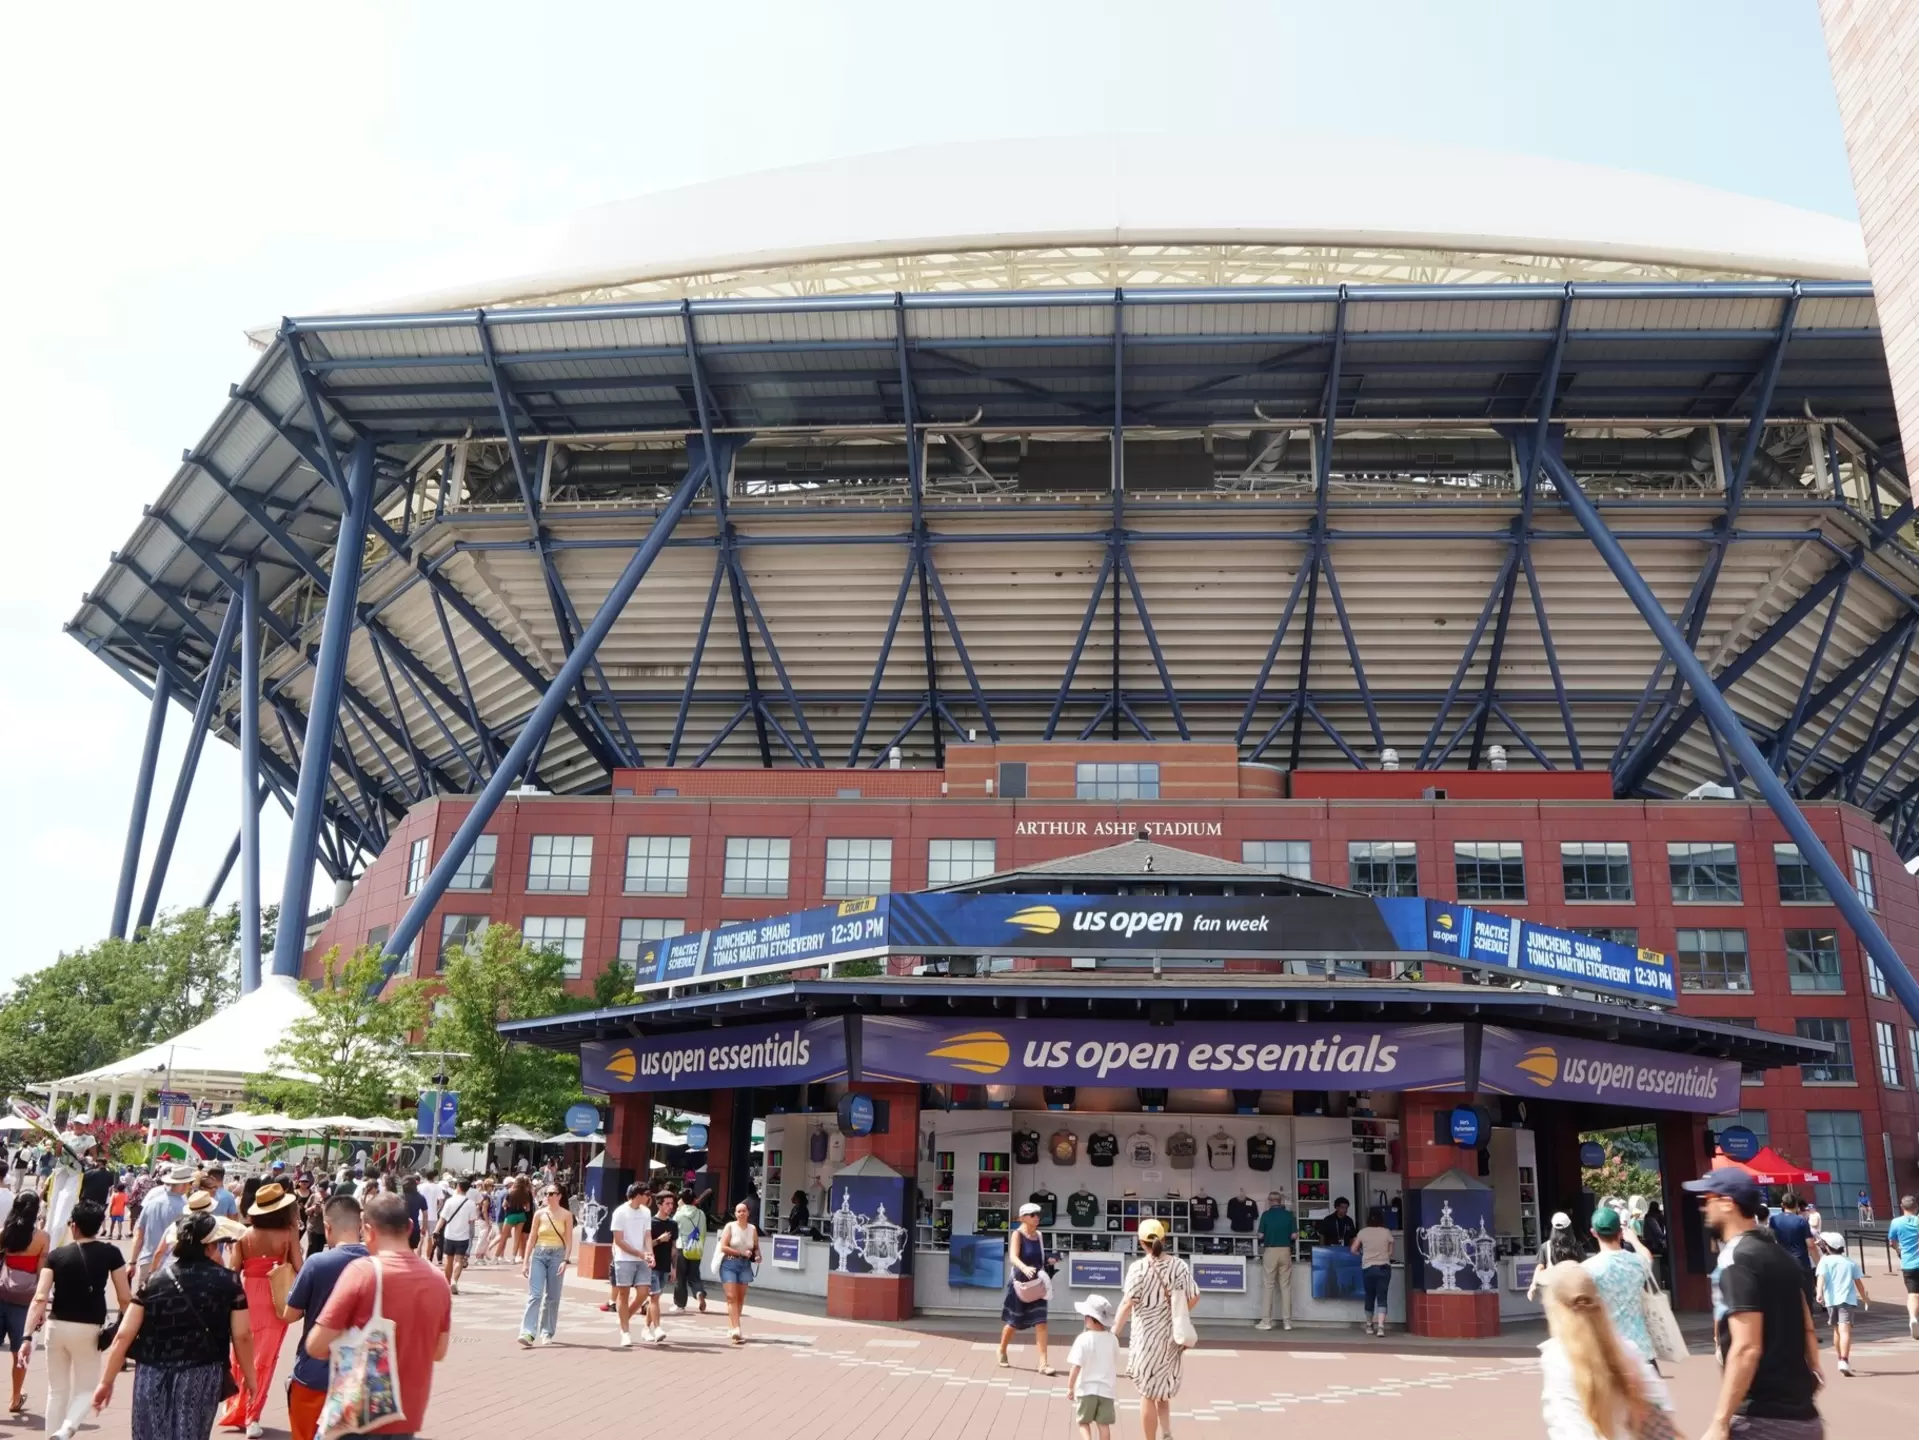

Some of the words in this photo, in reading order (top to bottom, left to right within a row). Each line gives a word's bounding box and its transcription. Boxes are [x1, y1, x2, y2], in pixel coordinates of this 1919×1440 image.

[1015, 821, 1088, 836] ARTHUR
[1093, 822, 1137, 836] ASHE
[1144, 822, 1222, 836] STADIUM
[844, 900, 865, 914] COURT
[713, 928, 757, 951] JUNCHENG
[760, 922, 791, 943] SHANG
[831, 920, 863, 945] 12:30
[865, 916, 884, 939] PM
[1073, 911, 1108, 931] us
[1109, 911, 1183, 938] open
[1193, 914, 1221, 931] fan
[1226, 915, 1270, 932] week
[1433, 930, 1441, 940] us
[1441, 932, 1458, 944] open
[1475, 921, 1510, 941] PRACTICE
[670, 942, 699, 958] PRACTICE
[712, 948, 738, 967] TOMAS
[739, 944, 769, 962] MARTIN
[770, 933, 825, 957] ETCHEVERRY
[1473, 936, 1509, 955] SCHEDULE
[1526, 931, 1571, 956] JUNCHENG
[1574, 941, 1602, 962] SHANG
[667, 955, 697, 970] SCHEDULE
[1526, 947, 1555, 969] TOMAS
[1556, 954, 1585, 975] MARTIN
[1586, 959, 1631, 984] ETCHEVERRY
[1634, 966, 1658, 988] 12:30
[1658, 970, 1673, 991] PM
[640, 1052, 660, 1075] us
[661, 1048, 704, 1082] open
[708, 1030, 810, 1071] essentials
[1023, 1040, 1072, 1068] us
[1075, 1041, 1180, 1079] open
[1187, 1034, 1399, 1073] essentials
[1563, 1057, 1587, 1084] us
[1587, 1060, 1635, 1095] open
[1636, 1065, 1719, 1099] essentials
